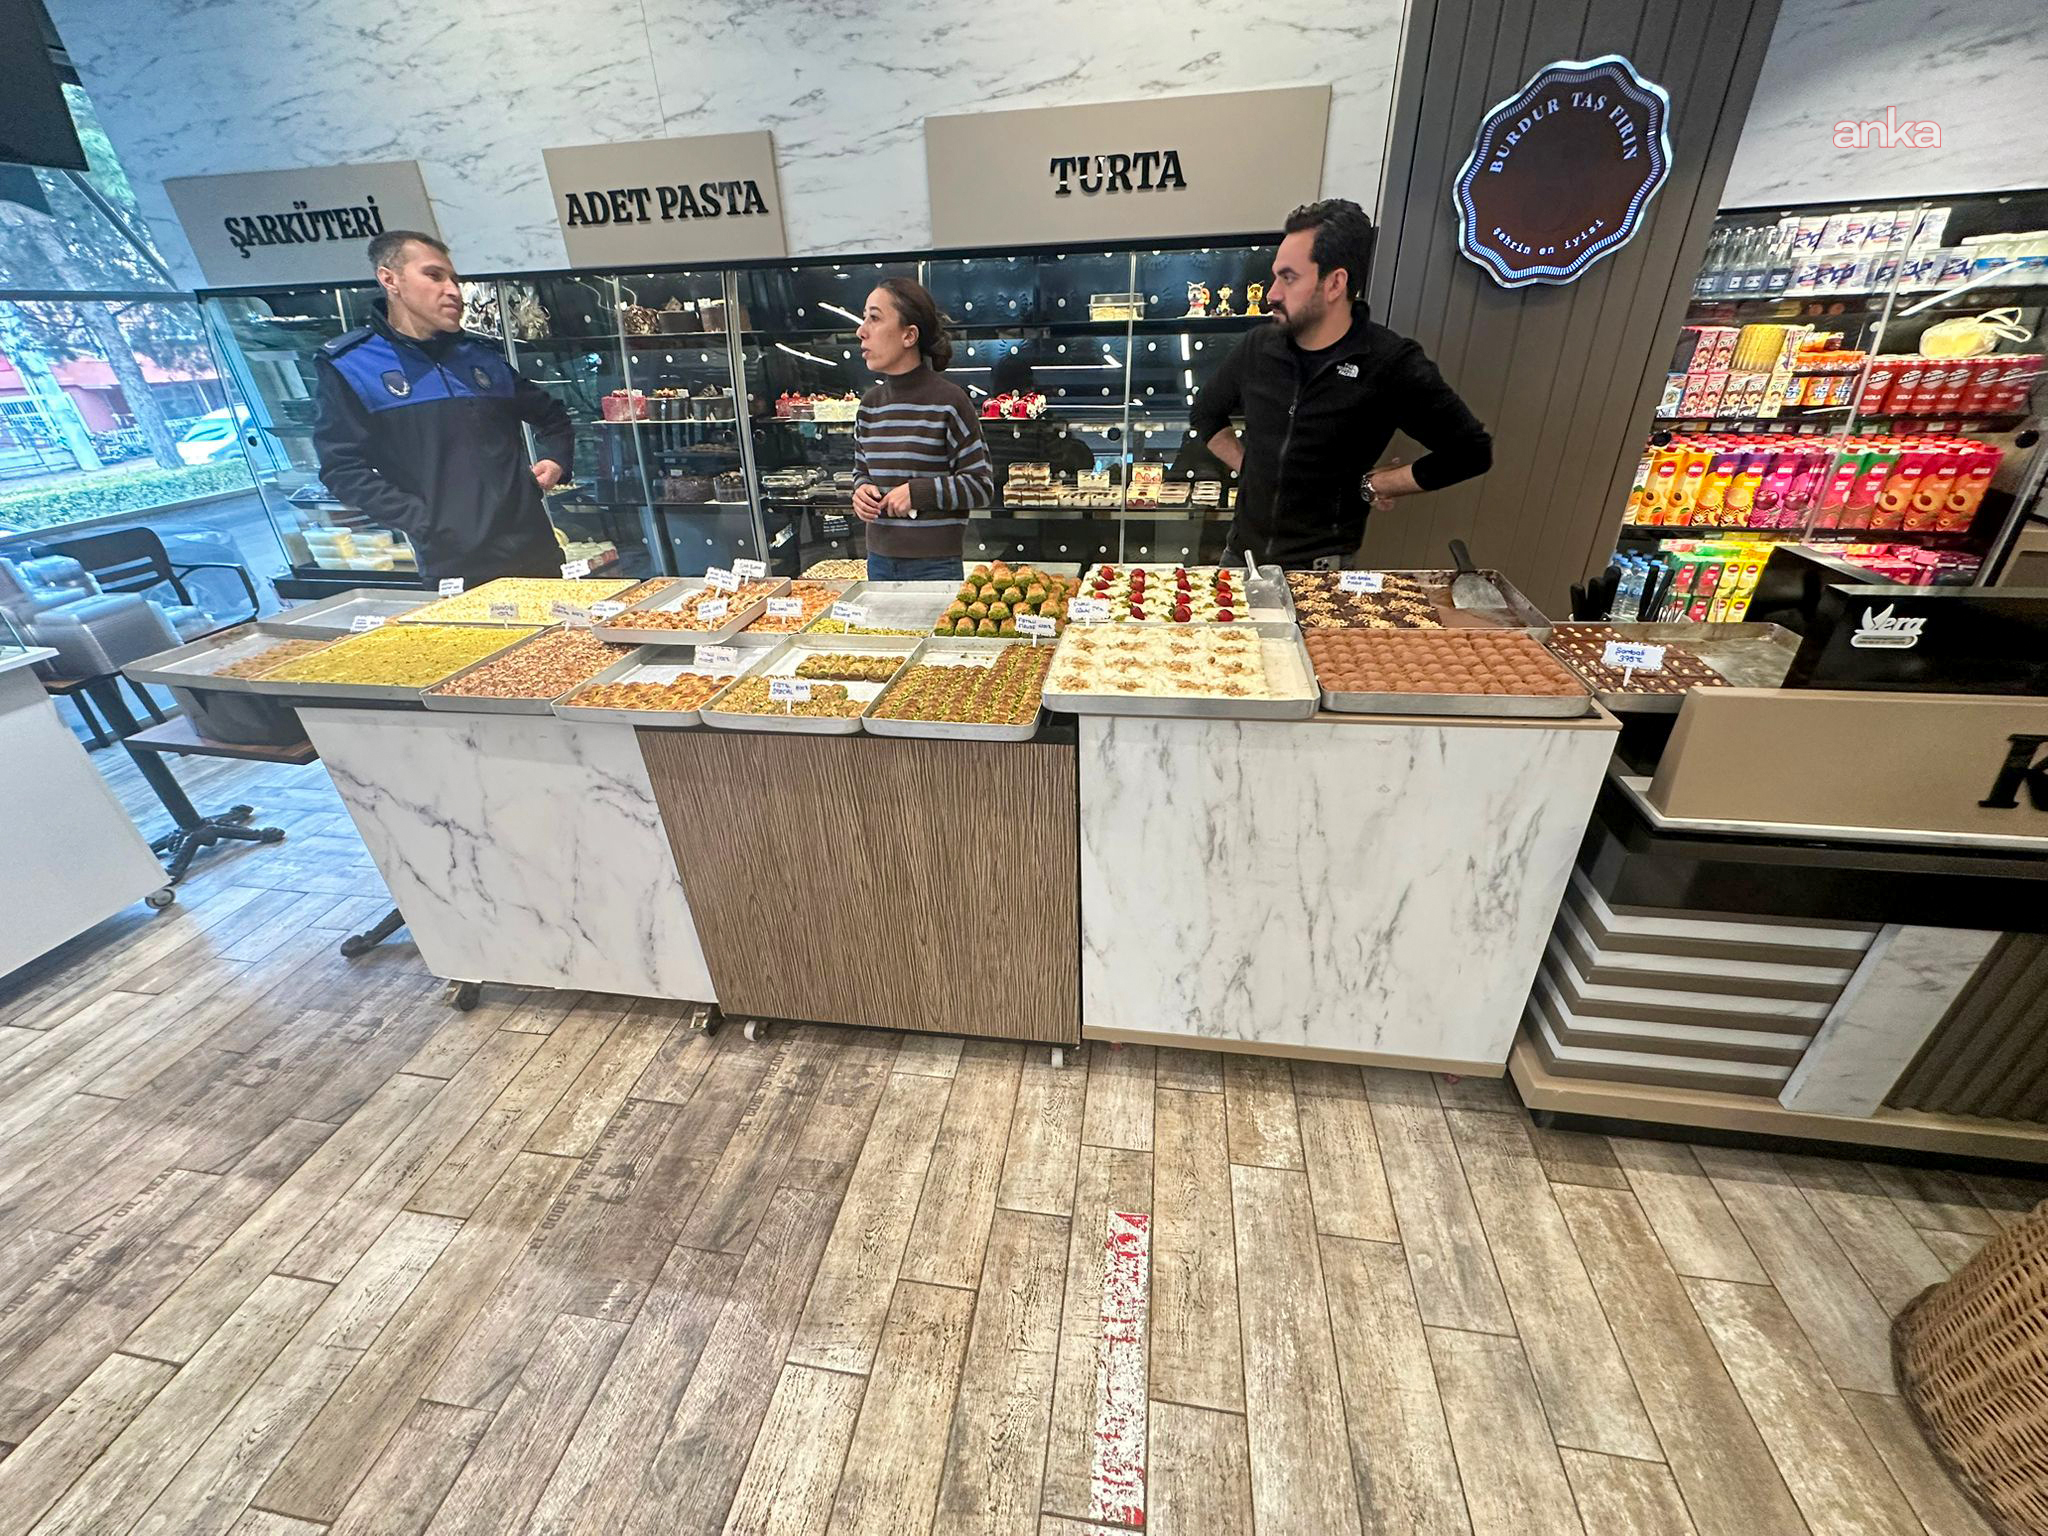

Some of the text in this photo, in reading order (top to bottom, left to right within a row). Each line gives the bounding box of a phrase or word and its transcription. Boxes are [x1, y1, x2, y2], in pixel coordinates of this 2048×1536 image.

[1489, 92, 1637, 173] BURDUR TAŞ FIRIN
[1050, 150, 1187, 195] TURTA
[565, 180, 769, 226] ADET PASTA
[224, 195, 384, 258] ŞARKÜTERİ
[1539, 246, 1555, 256] en
[1564, 218, 1604, 249] iyisi
